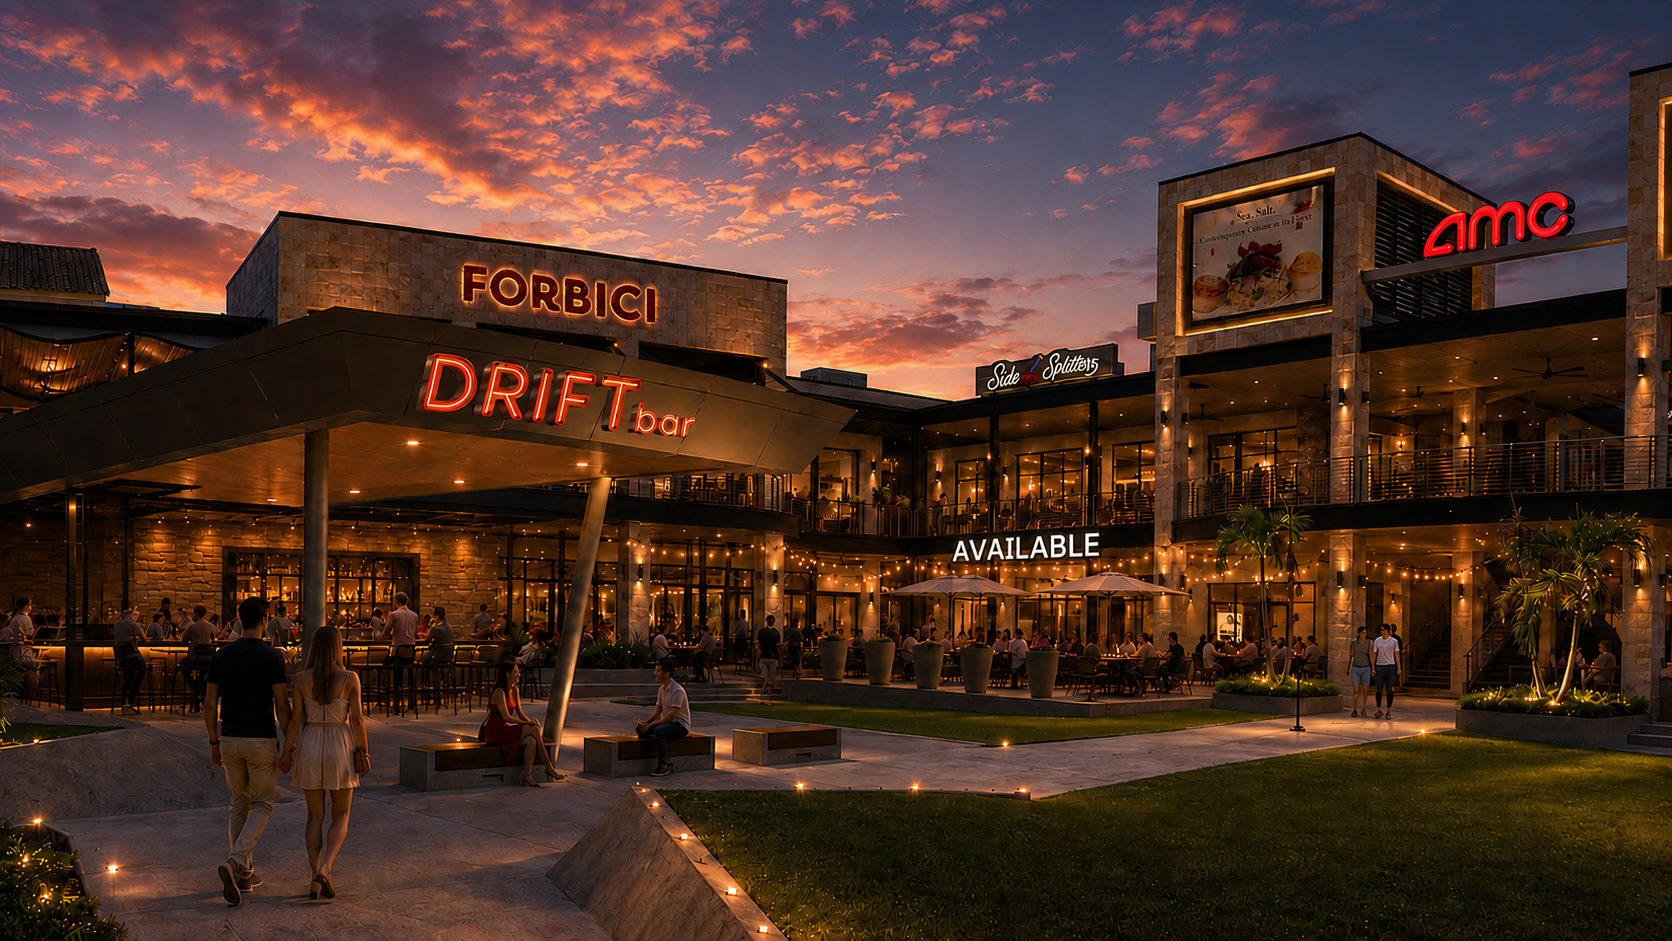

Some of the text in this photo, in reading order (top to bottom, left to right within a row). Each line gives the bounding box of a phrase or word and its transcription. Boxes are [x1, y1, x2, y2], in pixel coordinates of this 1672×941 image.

[462, 264, 657, 324] FORBICI
[421, 353, 696, 438] DRIFT bar
[987, 362, 1020, 391] Side
[952, 532, 1100, 562] AVAILABLE
